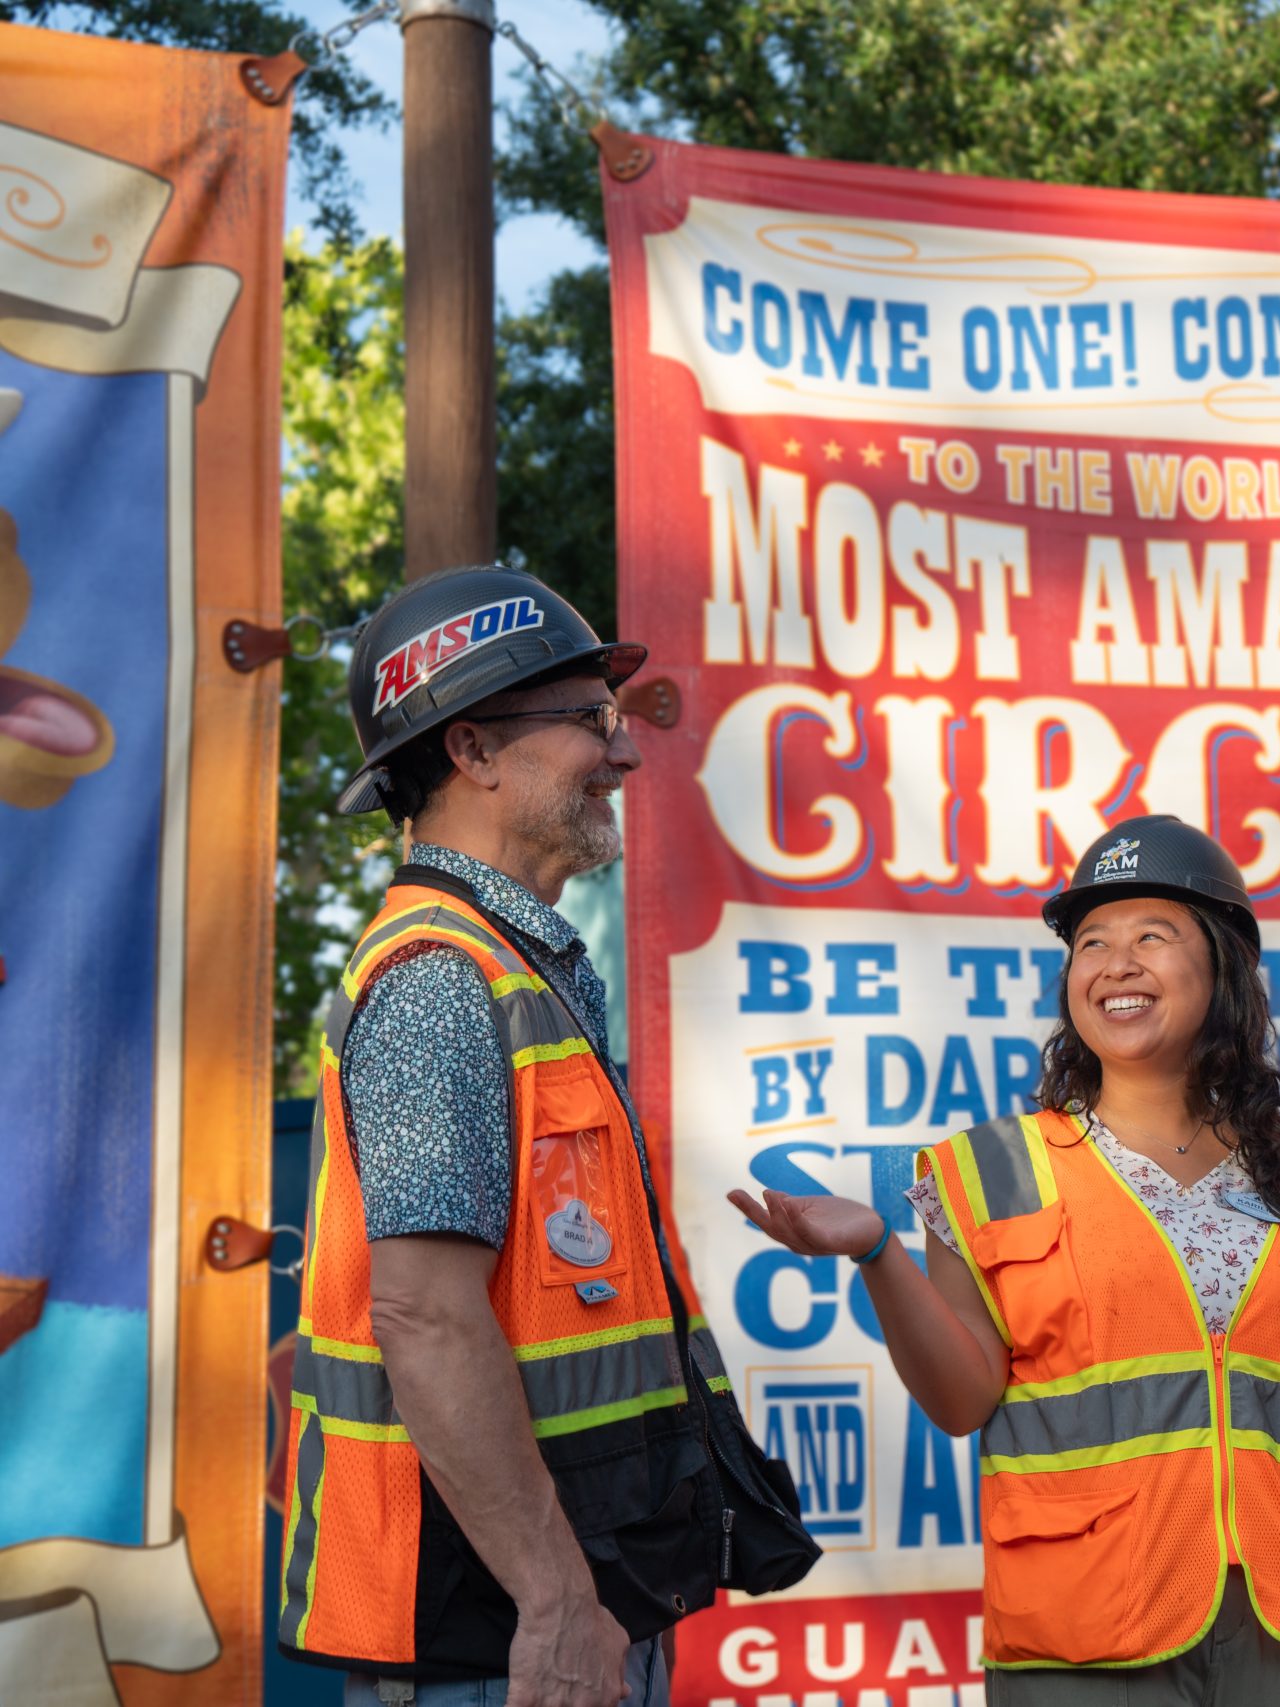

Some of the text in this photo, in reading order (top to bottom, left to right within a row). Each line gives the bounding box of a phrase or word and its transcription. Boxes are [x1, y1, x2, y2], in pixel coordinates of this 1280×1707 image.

[702, 261, 931, 391] COME
[962, 301, 1139, 392] ONE!
[899, 436, 980, 494] TO
[997, 444, 1113, 516] THE
[700, 434, 1031, 682] MOST
[374, 598, 543, 712] AMSOIL
[1095, 855, 1138, 875] FAM
[738, 940, 900, 1016] BE
[751, 1048, 834, 1125] BY
[865, 1034, 1046, 1128] DAR
[564, 1230, 585, 1243] BRAD
[763, 1403, 866, 1515] AND
